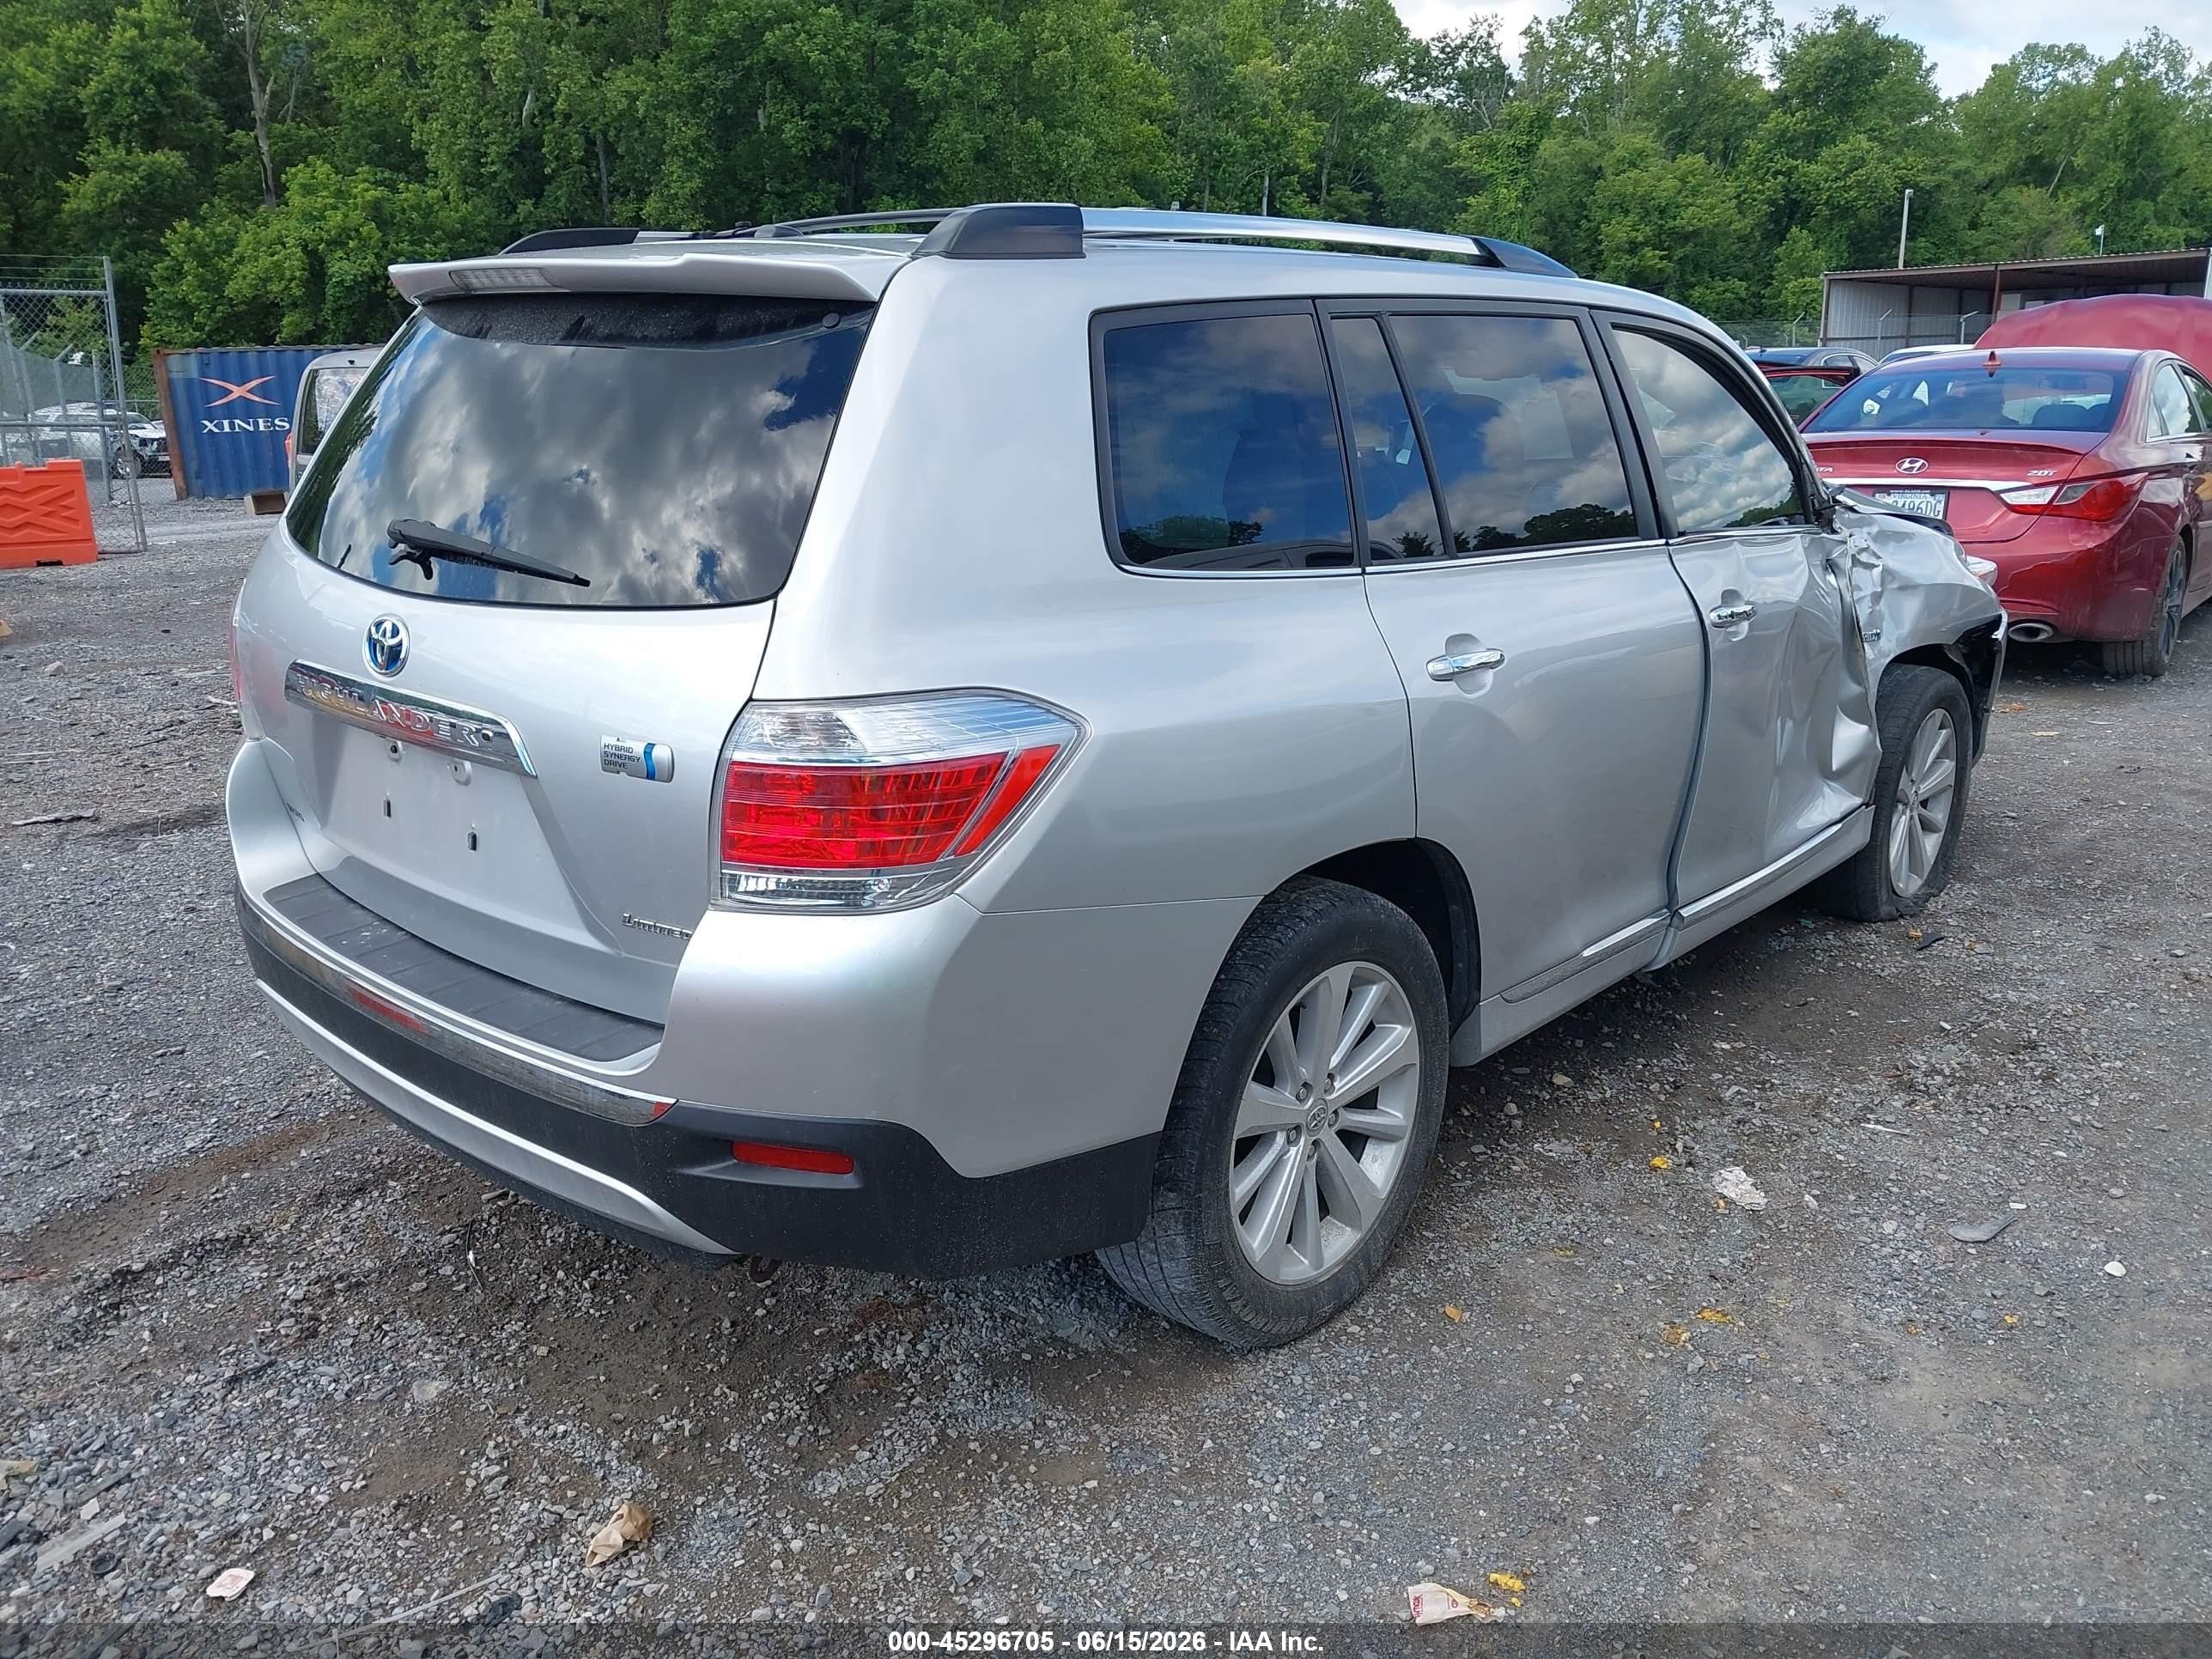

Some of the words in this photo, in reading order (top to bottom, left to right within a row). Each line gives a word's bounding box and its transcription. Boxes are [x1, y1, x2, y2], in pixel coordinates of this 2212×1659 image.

[199, 417, 290, 434] XINES
[295, 672, 479, 747] HIGHLANDER
[603, 742, 634, 754] HYBRID
[604, 750, 641, 763] SYNERGY
[604, 759, 629, 769] DRIVE
